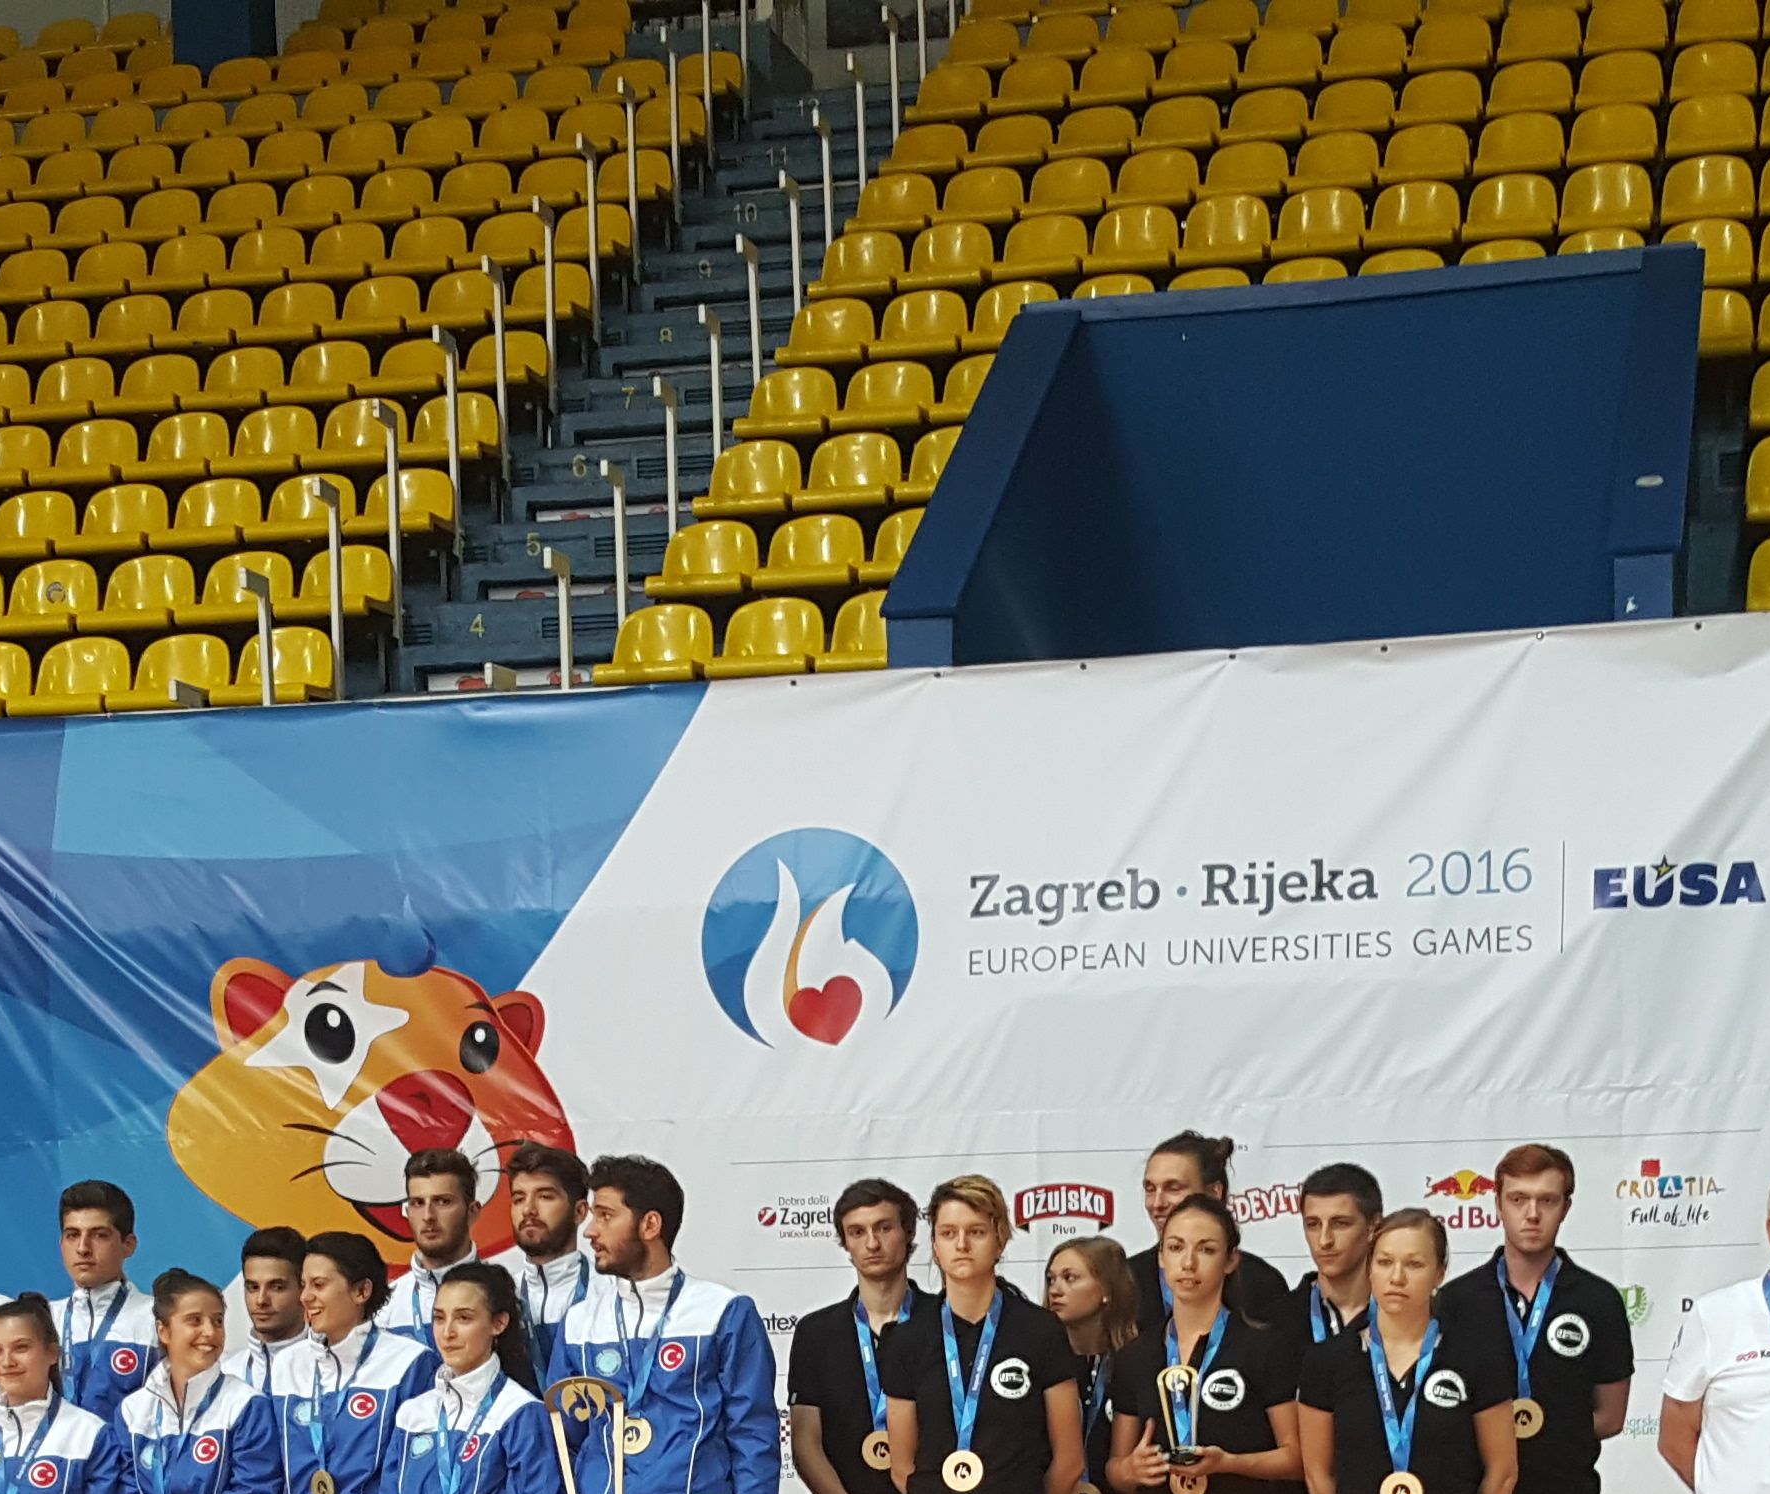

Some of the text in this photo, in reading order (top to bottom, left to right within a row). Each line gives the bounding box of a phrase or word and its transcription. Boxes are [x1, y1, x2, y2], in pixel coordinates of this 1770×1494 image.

[733, 203, 757, 223] 10
[621, 386, 635, 410] 7
[572, 454, 587, 478] 6
[526, 532, 541, 556] 5
[469, 613, 485, 638] 4
[969, 848, 1532, 926] Zagreb Rijeka 2016
[1593, 856, 1766, 910] EUSA
[969, 924, 1533, 976] EUROPEAN UNIVERSITIES GAMES
[1615, 1175, 1726, 1200] CROATIA
[1021, 1185, 1107, 1219] Ožujsko
[1228, 1183, 1304, 1224] DEVIT
[1631, 1203, 1660, 1224] Full
[1052, 1223, 1077, 1235] Pivo
